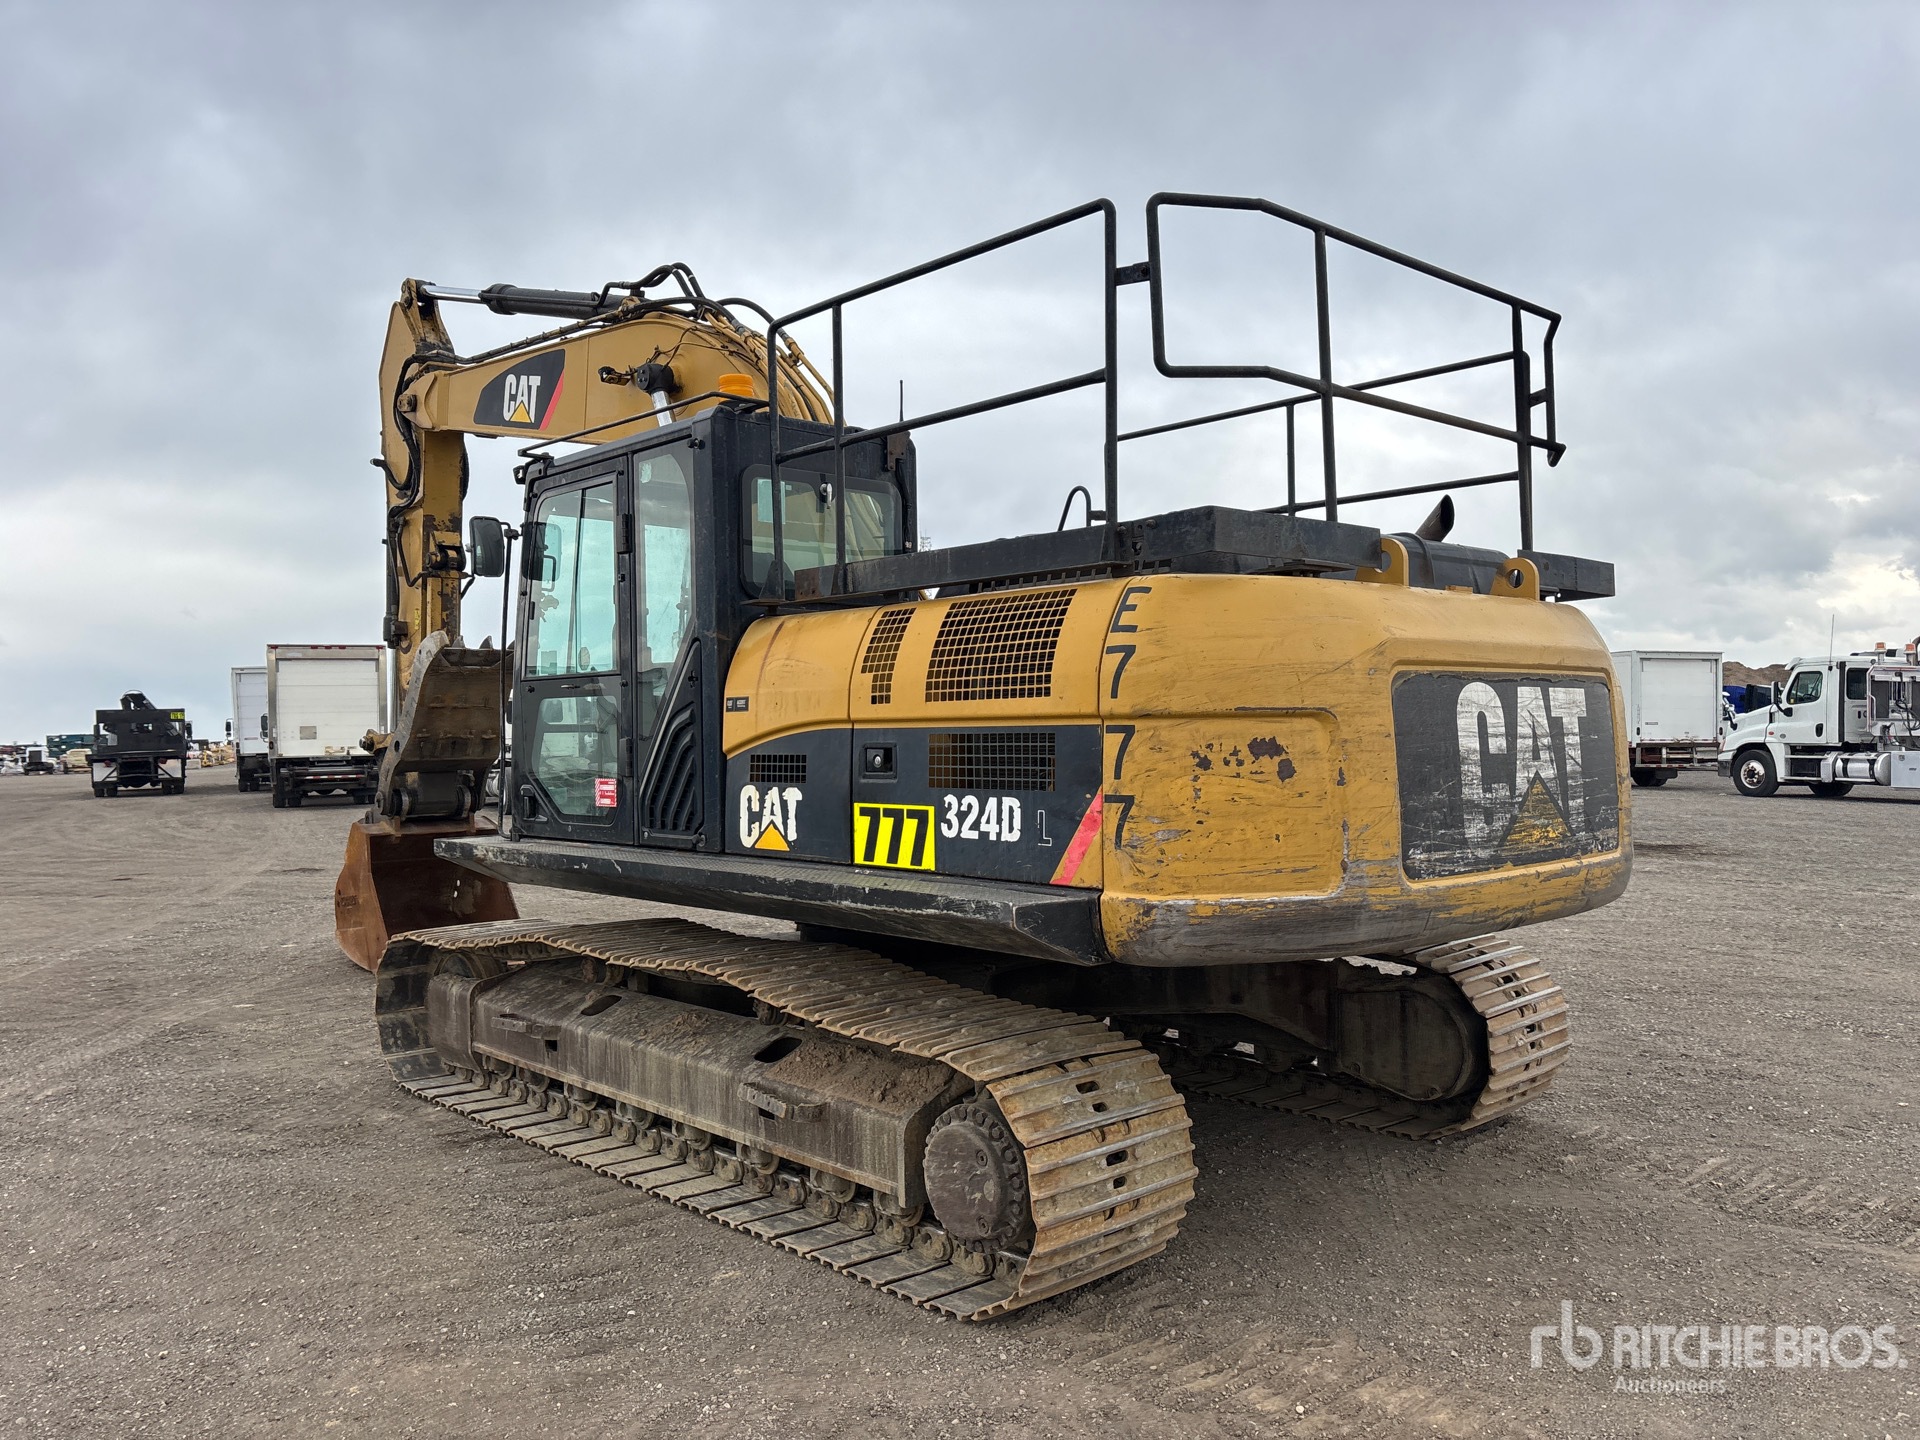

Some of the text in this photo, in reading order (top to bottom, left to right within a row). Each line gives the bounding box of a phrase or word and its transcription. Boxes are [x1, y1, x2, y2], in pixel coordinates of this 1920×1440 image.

[503, 374, 541, 423] CAT
[1456, 681, 1587, 858] CAT
[740, 784, 803, 849] CAT
[859, 806, 930, 867] 777
[940, 794, 1021, 842] 324D
